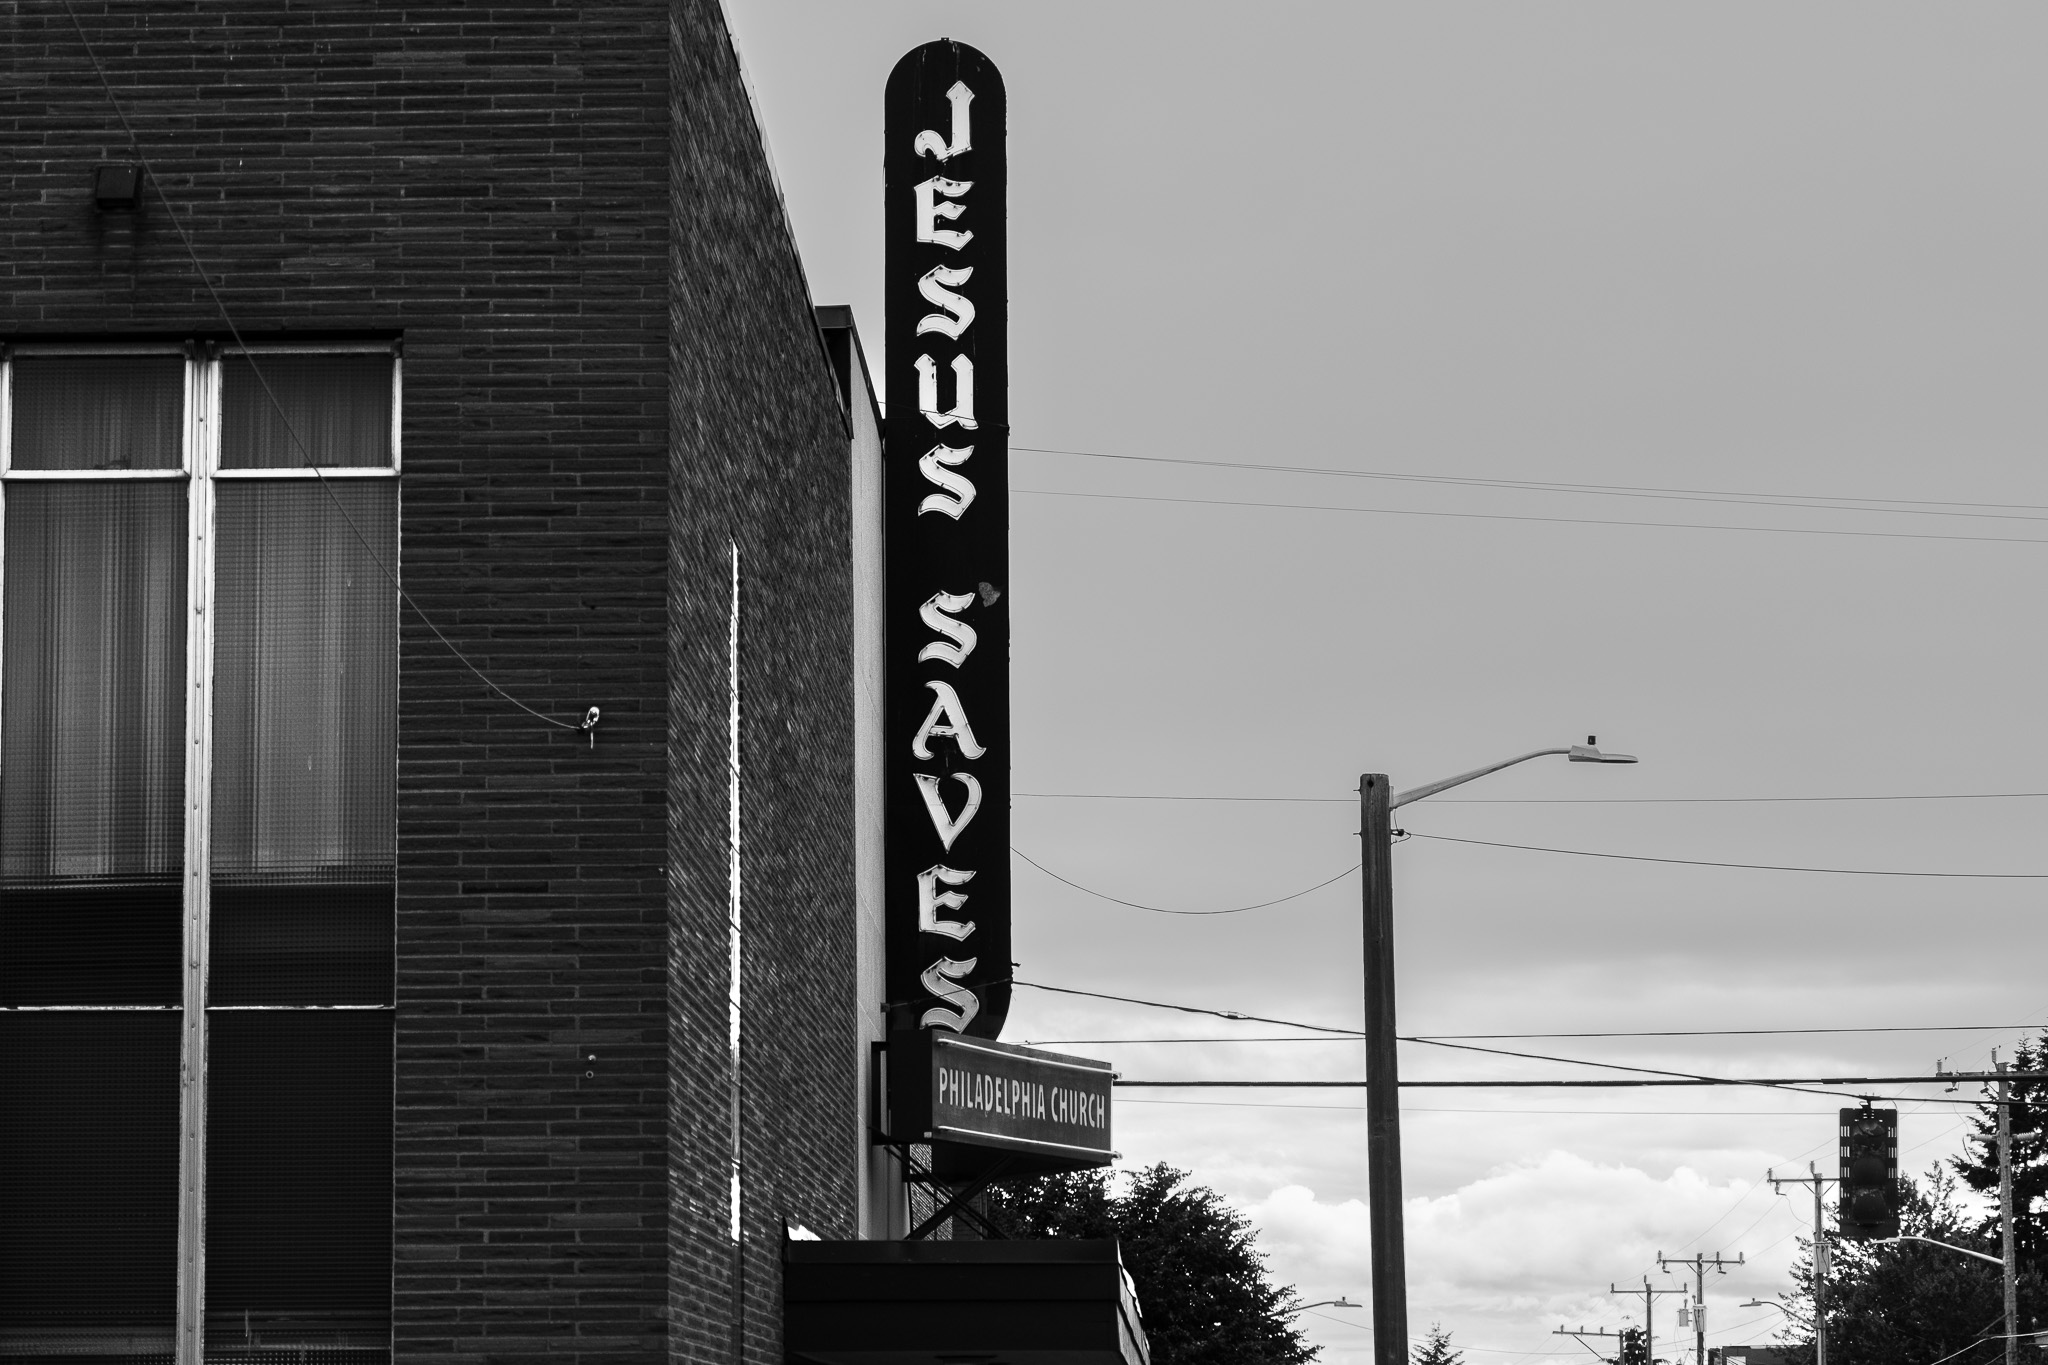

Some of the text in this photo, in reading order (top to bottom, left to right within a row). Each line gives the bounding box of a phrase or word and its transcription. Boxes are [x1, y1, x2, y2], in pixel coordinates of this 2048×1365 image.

[912, 80, 987, 1034] JESUS SAVES
[939, 1067, 1105, 1129] PHILADELPHIA CHURCH
